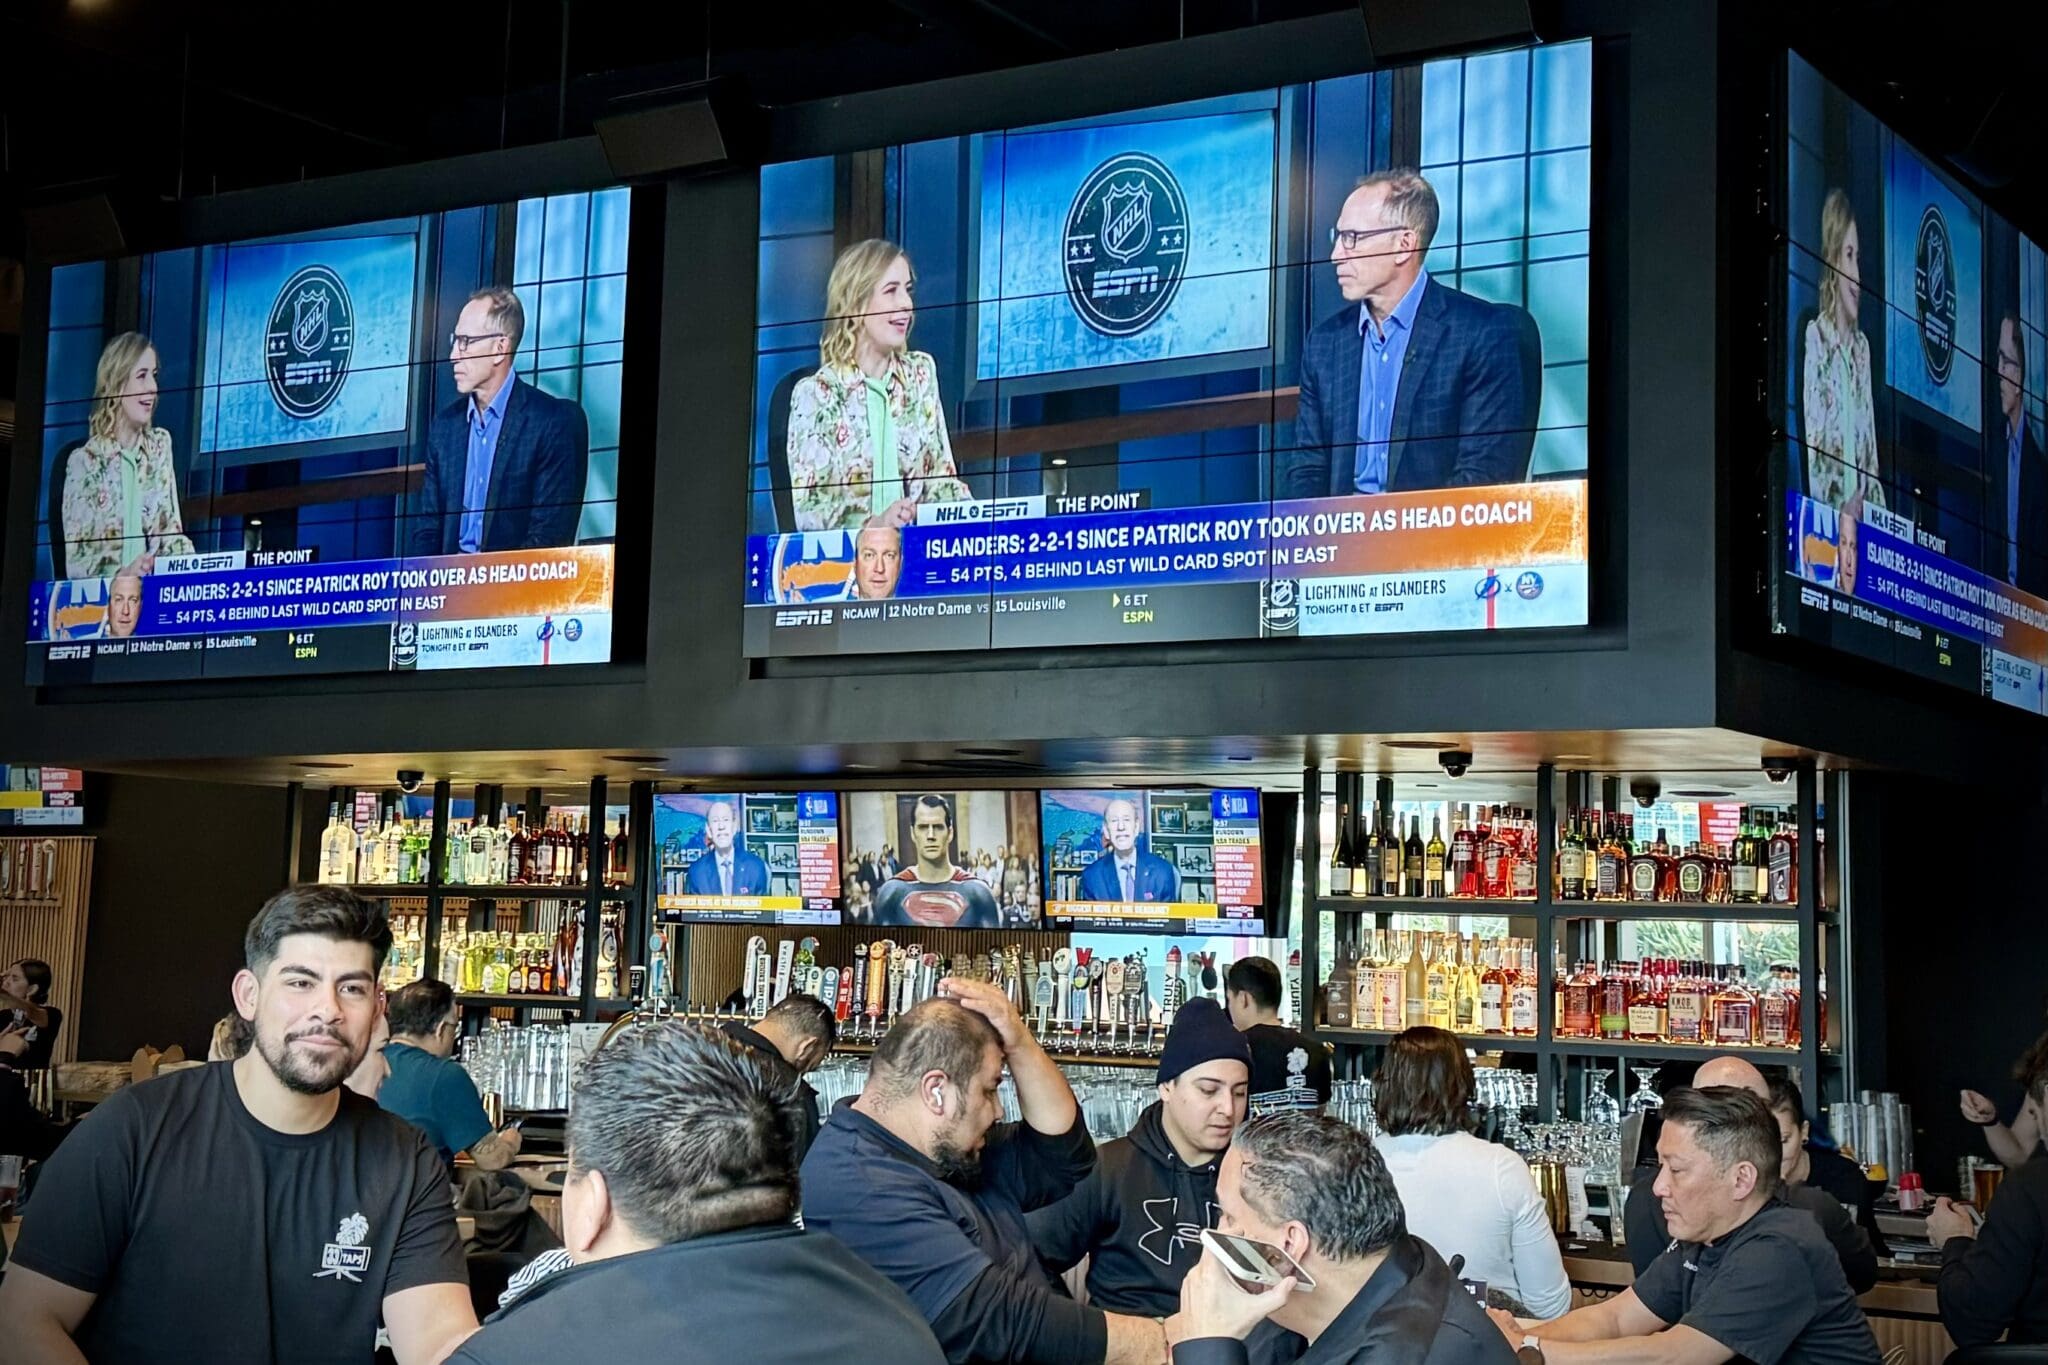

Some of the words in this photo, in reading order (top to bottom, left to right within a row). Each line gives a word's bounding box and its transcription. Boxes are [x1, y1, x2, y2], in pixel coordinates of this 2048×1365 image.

[1112, 201, 1142, 245] NHL
[1091, 266, 1159, 299] ESPN
[300, 306, 322, 341] NHL
[285, 360, 332, 386] ESPN
[936, 506, 968, 522] NHL
[982, 501, 1028, 519] ESPN
[1056, 496, 1087, 514] THE
[1090, 492, 1140, 512] POINT
[925, 534, 1026, 559] ISLANDERS:
[1028, 531, 1074, 554] 2-2-1
[1077, 527, 1129, 550] SINCE
[1133, 521, 1211, 547] PATRICK
[1215, 518, 1250, 540] ROY
[1257, 514, 1310, 538] TOOK
[1313, 511, 1366, 535] OVER
[1370, 510, 1398, 532] AS
[1401, 505, 1457, 530] HEAD
[1460, 500, 1533, 526] COACH
[1917, 529, 1927, 547] THE
[1929, 534, 1946, 554] POINT
[168, 559, 190, 572] NHL
[200, 556, 233, 570] ESPN
[253, 553, 274, 566] THE
[277, 550, 312, 564] POINT
[950, 567, 970, 584] 54
[973, 565, 1007, 583] PTS,
[1011, 565, 1022, 580] 4
[1026, 562, 1083, 579] BEHIND
[1086, 558, 1126, 576] LAST
[1129, 555, 1169, 574] WILD
[1173, 553, 1218, 572] CARD
[1222, 550, 1267, 569] SPOT
[1272, 549, 1289, 566] IN
[1294, 546, 1338, 564] EAST
[159, 583, 229, 603] ISLANDERS:
[232, 581, 263, 599] 2-2-1
[268, 579, 303, 596] SINCE
[305, 574, 359, 594] PATRICK
[362, 572, 390, 590] ROY
[392, 569, 428, 588] TOOK
[430, 567, 465, 586] OVER
[468, 566, 487, 584] AS
[490, 564, 527, 582] HEAD
[529, 561, 578, 580] COACH
[1305, 584, 1365, 600] LIGHTNING
[1370, 587, 1378, 596] AT
[1381, 579, 1446, 597] ISLANDERS
[842, 608, 880, 621] NCAAW
[889, 606, 900, 618] 12
[902, 603, 935, 617] Notre
[938, 602, 972, 616] Dame
[977, 604, 989, 614] vs
[995, 600, 1007, 613] 15
[1010, 597, 1066, 612] Louisville
[1124, 596, 1131, 608] 6
[1134, 595, 1148, 607] ET
[1305, 604, 1349, 615] TONIGHT
[1360, 603, 1370, 613] ET
[1374, 602, 1404, 612] ESPN
[1801, 587, 1829, 611] ESPN2
[176, 611, 189, 624] 54
[192, 609, 216, 623] PTS,
[219, 609, 225, 620] 4
[229, 607, 268, 620] BEHIND
[272, 604, 300, 618] LAST
[302, 602, 329, 616] WILD
[332, 600, 364, 614] CARD
[367, 598, 397, 613] SPOT
[400, 597, 411, 610] IN
[415, 596, 446, 609] EAST
[776, 609, 833, 627] ESPN2
[1123, 611, 1154, 623] ESPN
[297, 635, 302, 644] 6
[304, 634, 313, 643] ET
[422, 627, 463, 640] LIGHTNING
[466, 629, 472, 638] AT
[474, 624, 518, 638] ISLANDERS
[49, 645, 90, 660] ESPN2
[98, 643, 124, 654] NCAAW
[131, 642, 138, 652] 12
[140, 641, 163, 652] Notre
[166, 640, 190, 651] Dame
[193, 640, 202, 649] vs
[206, 638, 214, 648] 15
[216, 636, 256, 648] Louisville
[295, 648, 317, 658] ESPN
[422, 643, 451, 653] TONIGHT
[469, 642, 488, 650] ESPN
[823, 985, 834, 1006] IPA
[1163, 974, 1174, 1014] TRULY
[342, 1253, 364, 1265] TAPS
